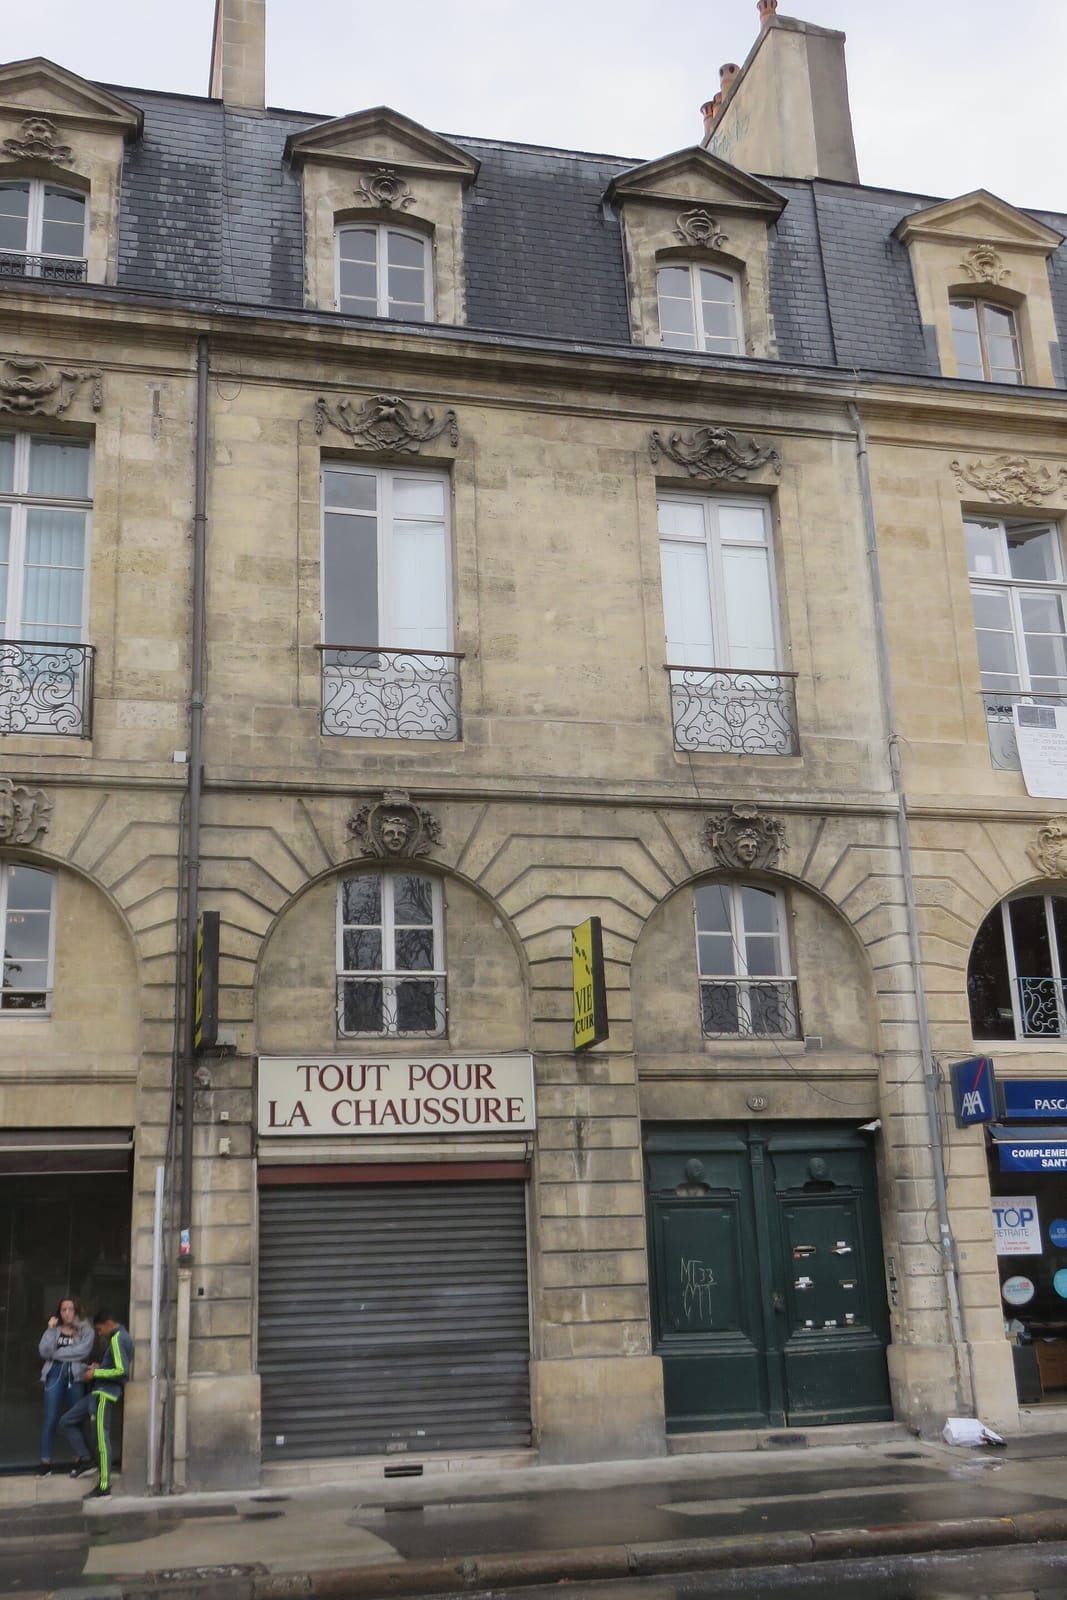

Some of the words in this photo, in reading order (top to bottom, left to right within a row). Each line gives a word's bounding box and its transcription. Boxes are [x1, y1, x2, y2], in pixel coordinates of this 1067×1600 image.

[575, 984, 592, 1016] VIE
[575, 1013, 595, 1034] CUIR
[297, 1064, 390, 1092] TOUT
[408, 1063, 496, 1091] POUR
[752, 1096, 764, 1107] 29
[961, 1090, 985, 1117] AXA
[1034, 1099, 1067, 1110] PASC
[268, 1100, 312, 1128] LA
[331, 1097, 526, 1126] CHAUSSURE
[1011, 1148, 1067, 1158] COMPLEME
[992, 1208, 1034, 1228] TOP
[993, 1228, 1029, 1238] RETRAITE
